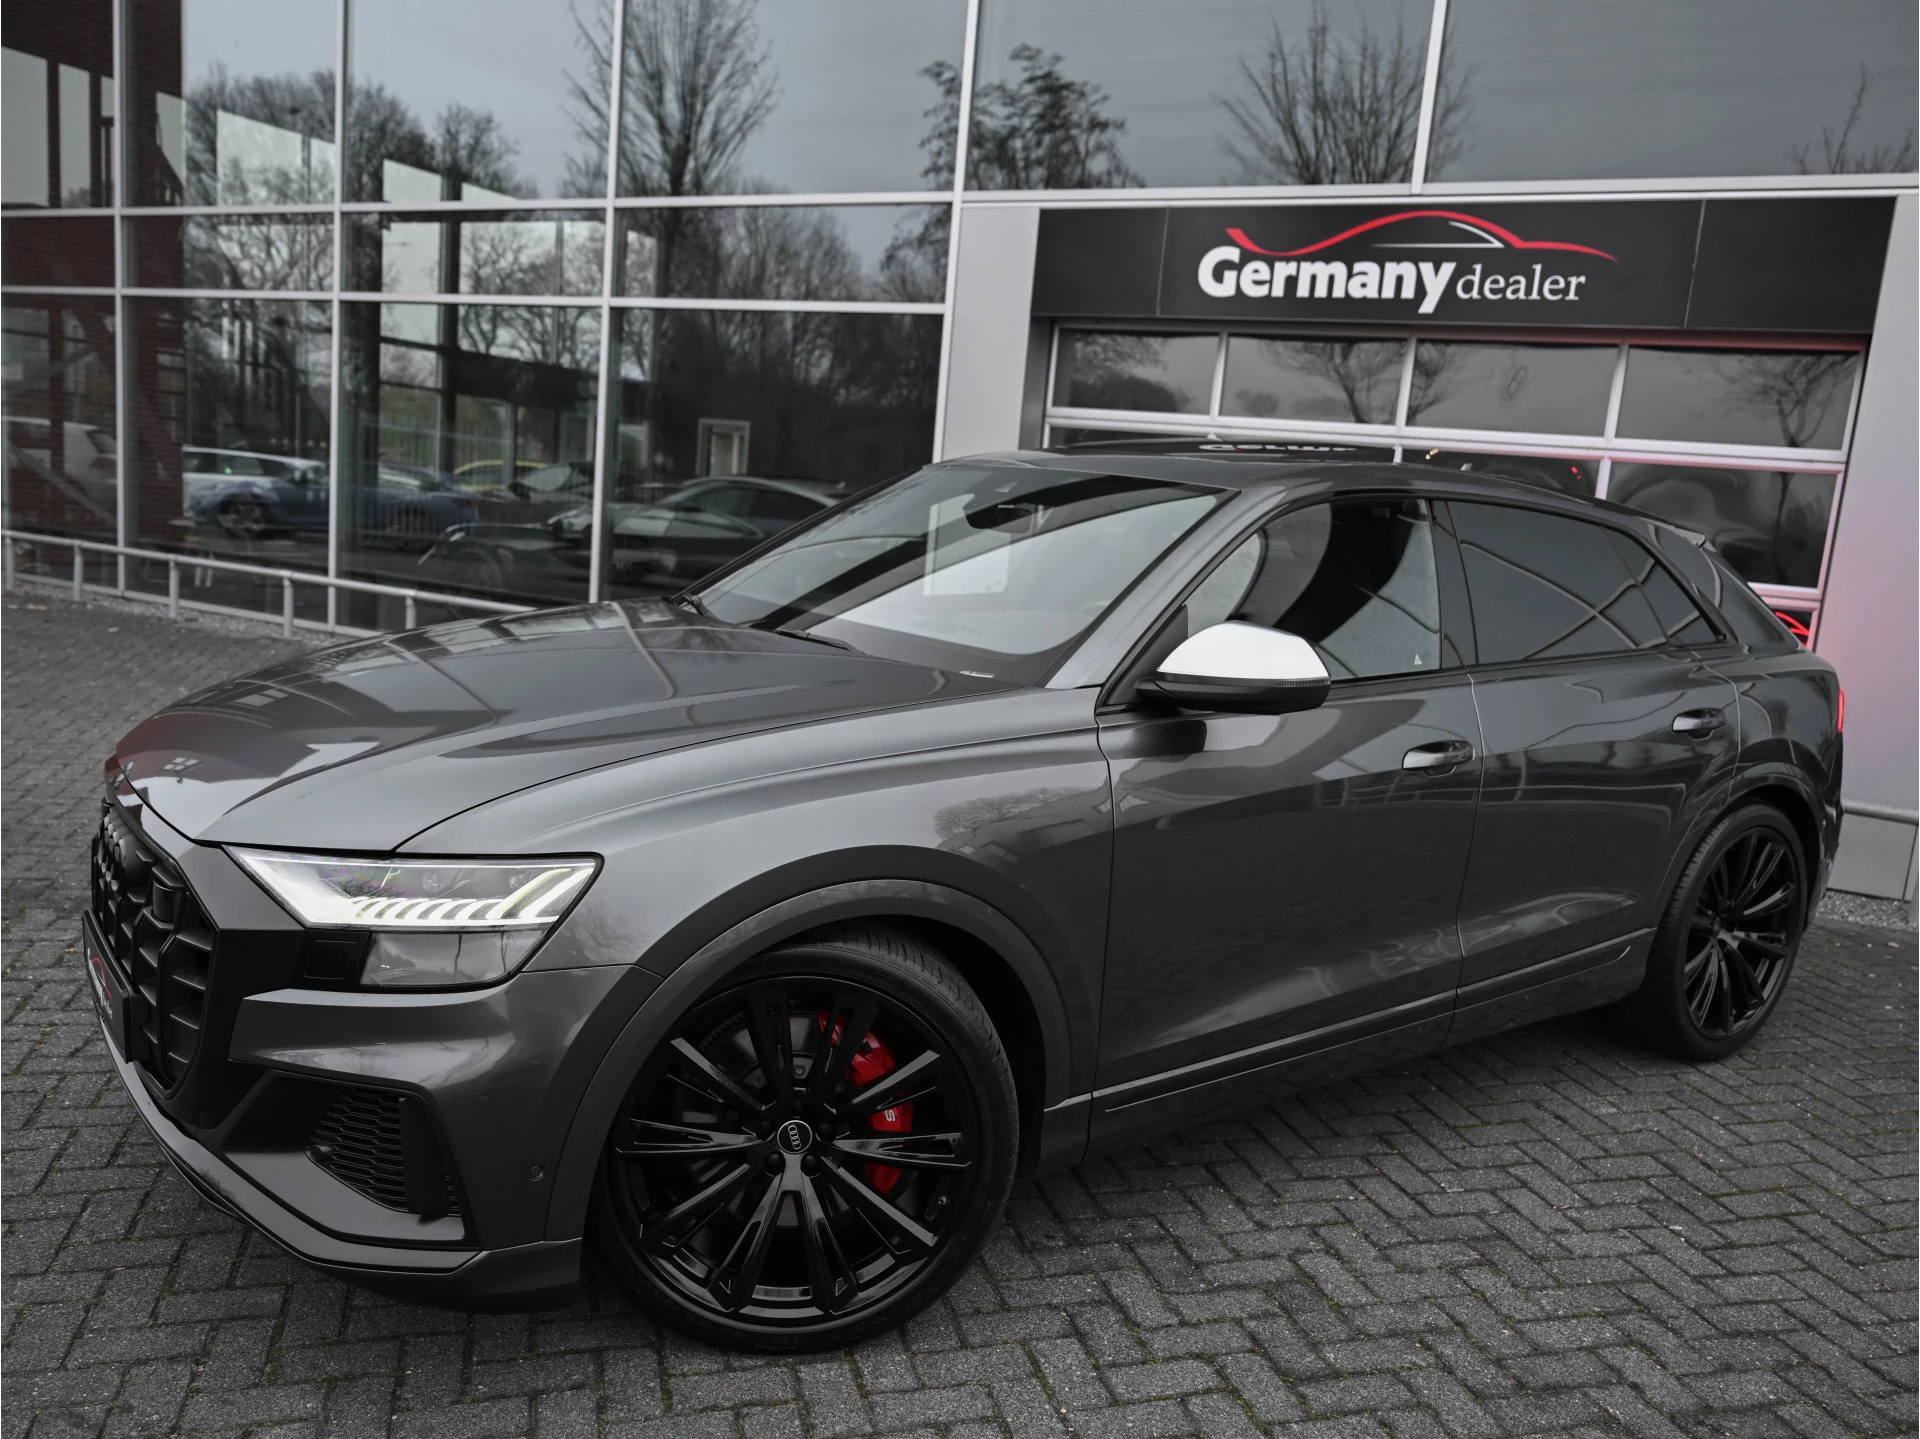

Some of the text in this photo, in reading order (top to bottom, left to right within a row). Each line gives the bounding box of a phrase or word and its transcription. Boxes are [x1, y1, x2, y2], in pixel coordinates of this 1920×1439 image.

[1198, 245, 1586, 314] Germany dealer
[884, 1109, 896, 1122] S
